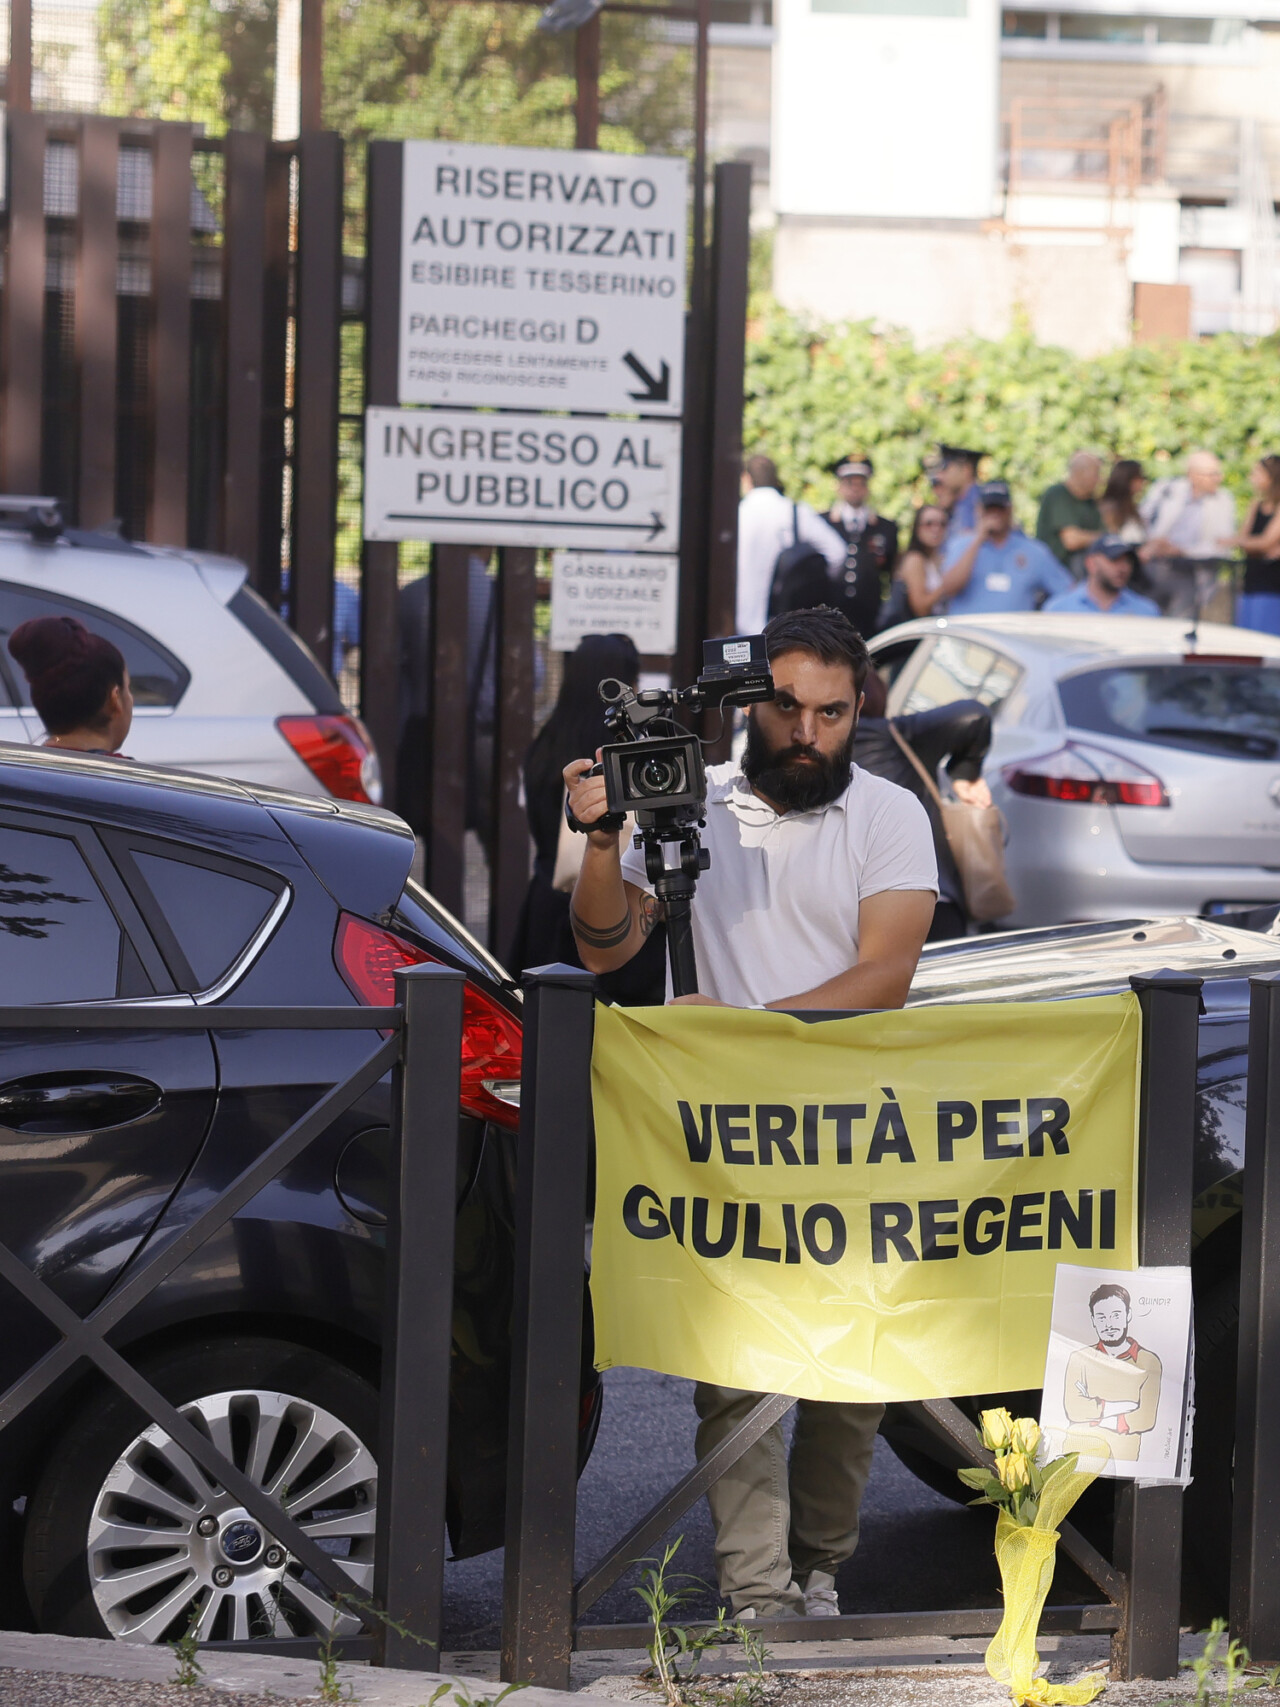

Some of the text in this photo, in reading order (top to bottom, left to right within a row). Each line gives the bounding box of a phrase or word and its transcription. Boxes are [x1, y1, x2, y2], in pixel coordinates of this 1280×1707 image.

[435, 165, 657, 209] RISERVATO
[412, 216, 676, 260] AUTORIZZATI
[411, 261, 677, 299] ESIBIRE TESSERINO
[409, 313, 600, 345] PARCHEGGI D
[408, 349, 503, 367] PROCEDERE
[408, 369, 452, 383] FARSI
[383, 424, 663, 470] INGRESSO AL
[416, 471, 630, 511] PUBBLICO
[566, 585, 662, 602] GUDIZIALE
[676, 1087, 1071, 1166] VERITÀ PER
[622, 1184, 1117, 1266] GIULIO REGENI
